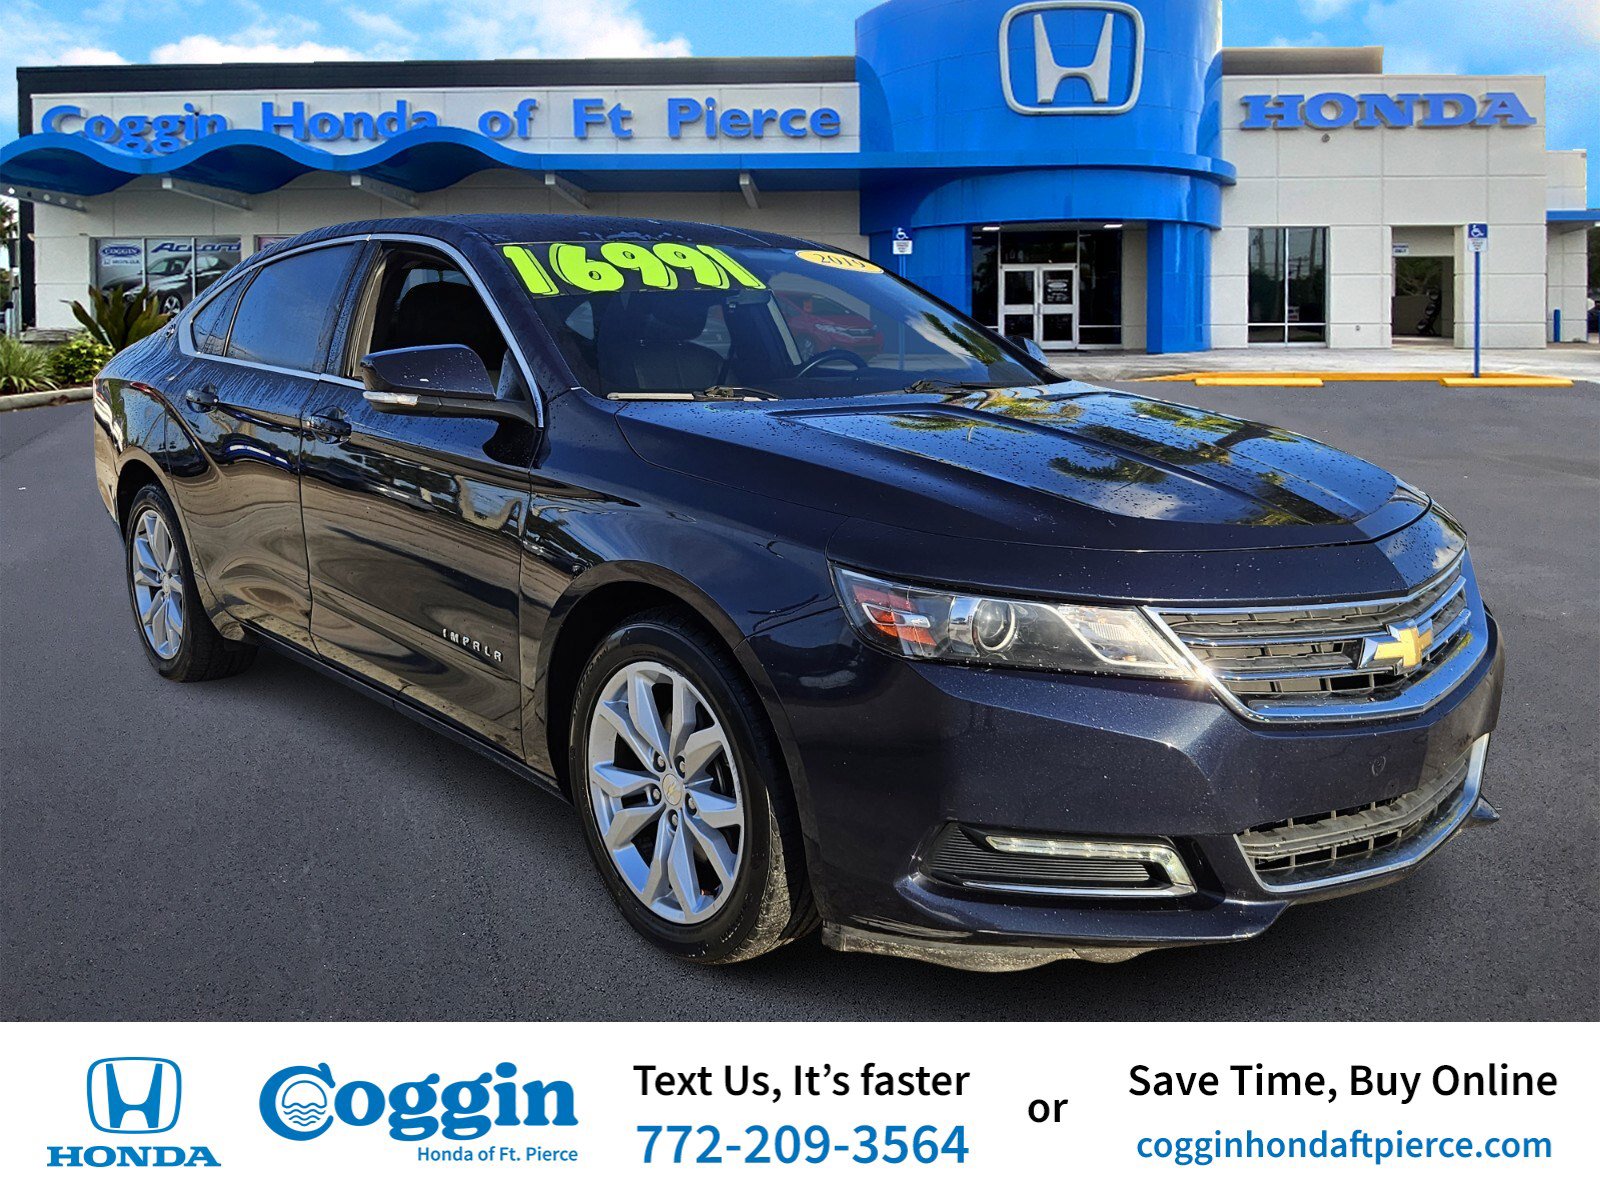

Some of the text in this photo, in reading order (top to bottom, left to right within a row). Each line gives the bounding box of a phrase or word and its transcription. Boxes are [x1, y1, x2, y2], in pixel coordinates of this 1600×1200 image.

[42, 98, 841, 155] Coggin Honda of Ft Pierce
[1240, 92, 1537, 130] HONDA
[503, 242, 767, 295] 16991
[442, 628, 502, 662] IMPALA
